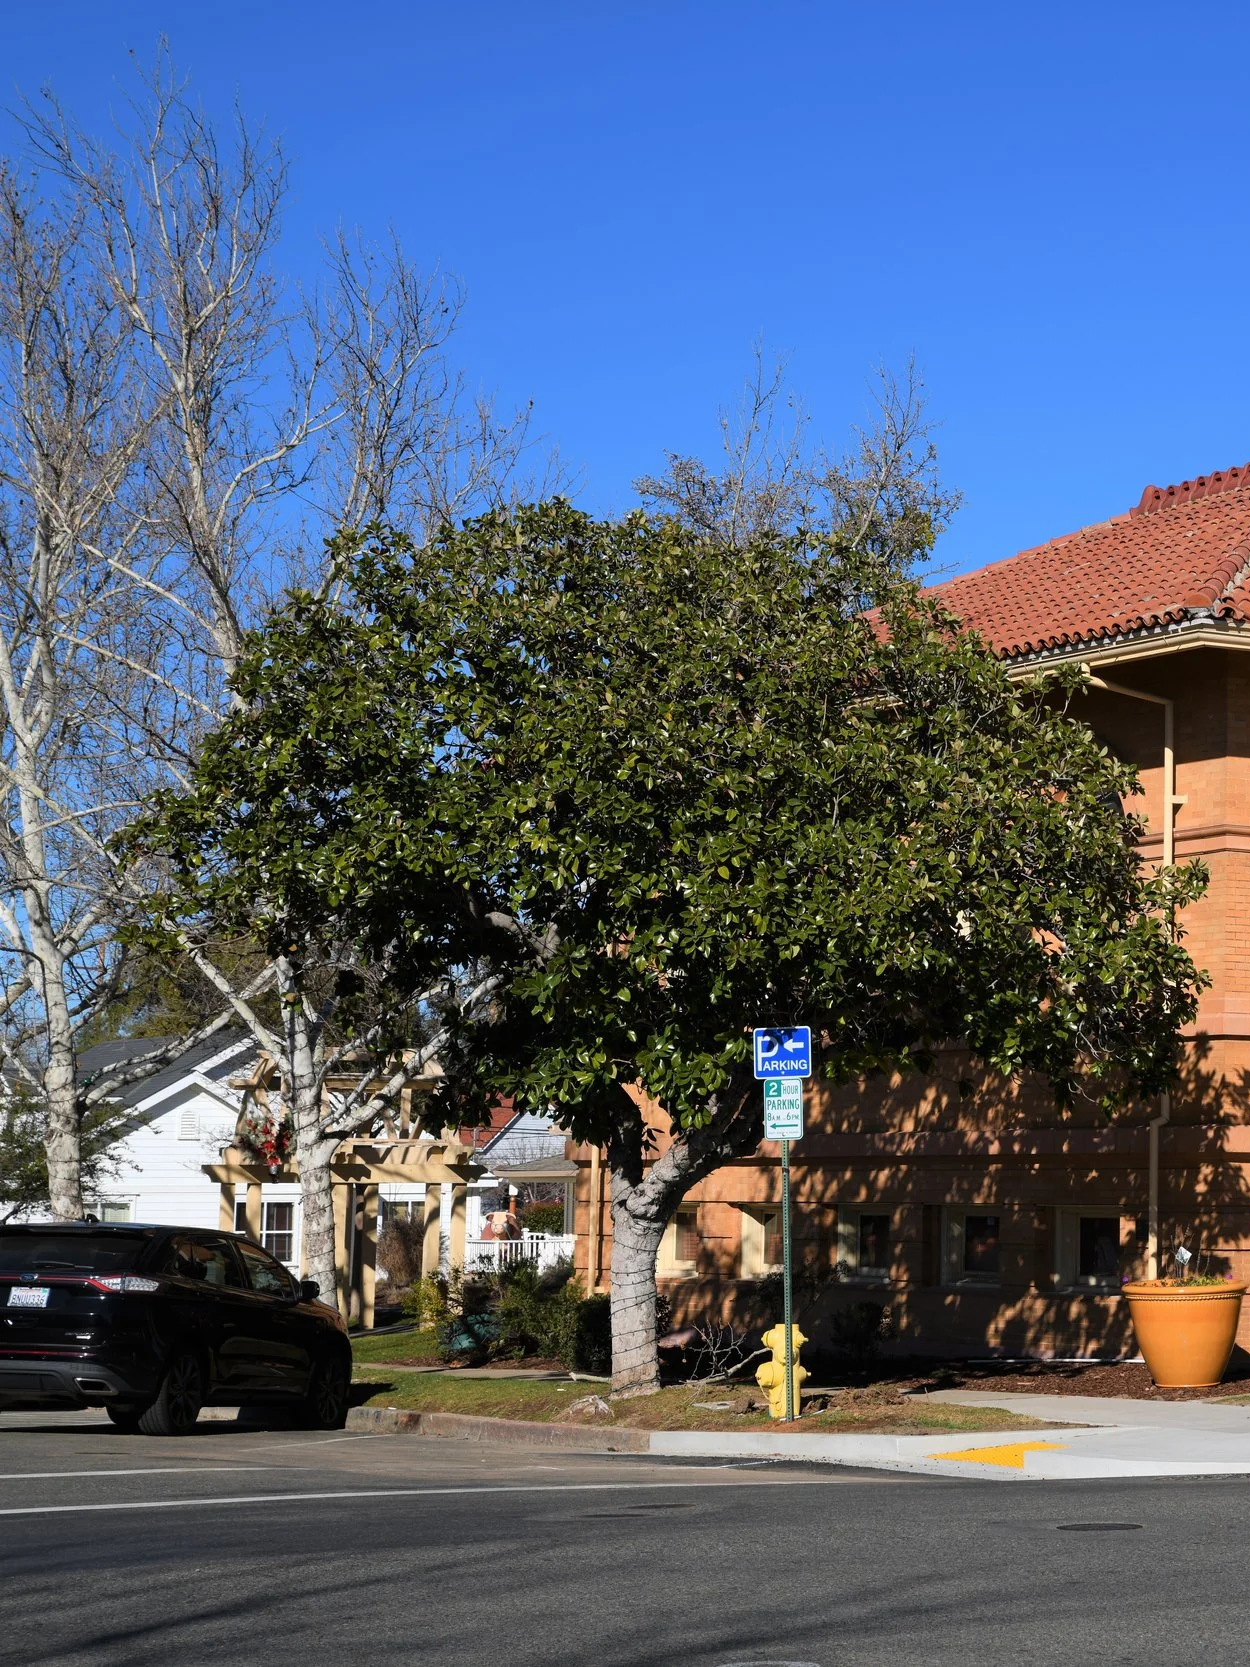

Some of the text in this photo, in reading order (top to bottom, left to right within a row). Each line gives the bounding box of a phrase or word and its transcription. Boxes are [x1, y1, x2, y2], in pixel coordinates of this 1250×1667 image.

[757, 1036, 808, 1071] PARKING
[769, 1082, 799, 1095] 2 HOUR
[767, 1099, 800, 1110] PARKING
